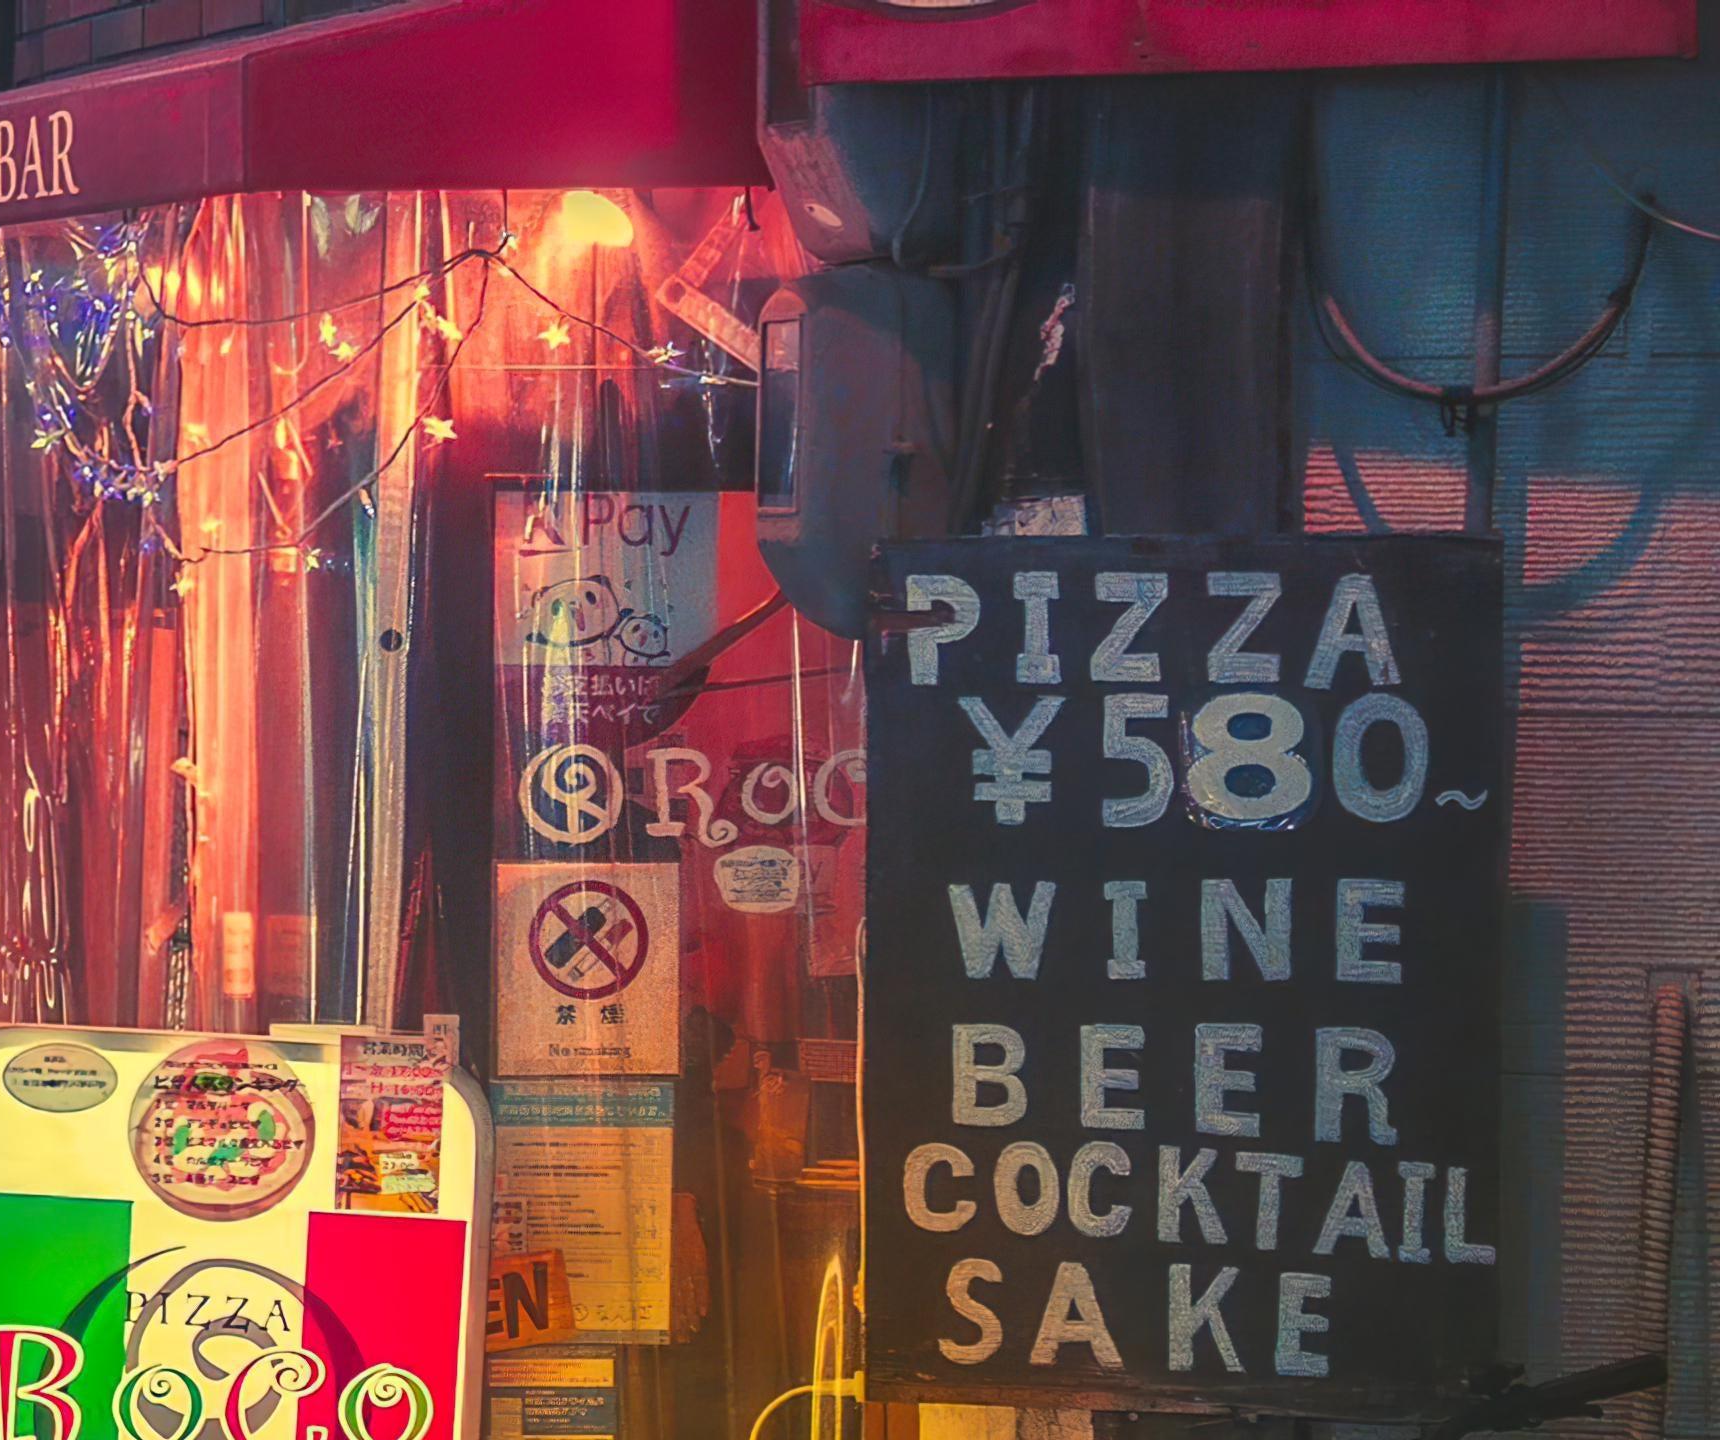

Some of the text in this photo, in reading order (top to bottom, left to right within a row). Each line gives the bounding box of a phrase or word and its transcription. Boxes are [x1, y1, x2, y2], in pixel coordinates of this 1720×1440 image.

[582, 491, 691, 558] Pay
[905, 570, 1402, 690] PIZZA
[948, 877, 1407, 985] WINE
[951, 1022, 1399, 1147] BEER
[902, 1141, 1498, 1265] COCKTAIL
[125, 1291, 291, 1333] PIZZA
[938, 1257, 1333, 1379] SAKE
